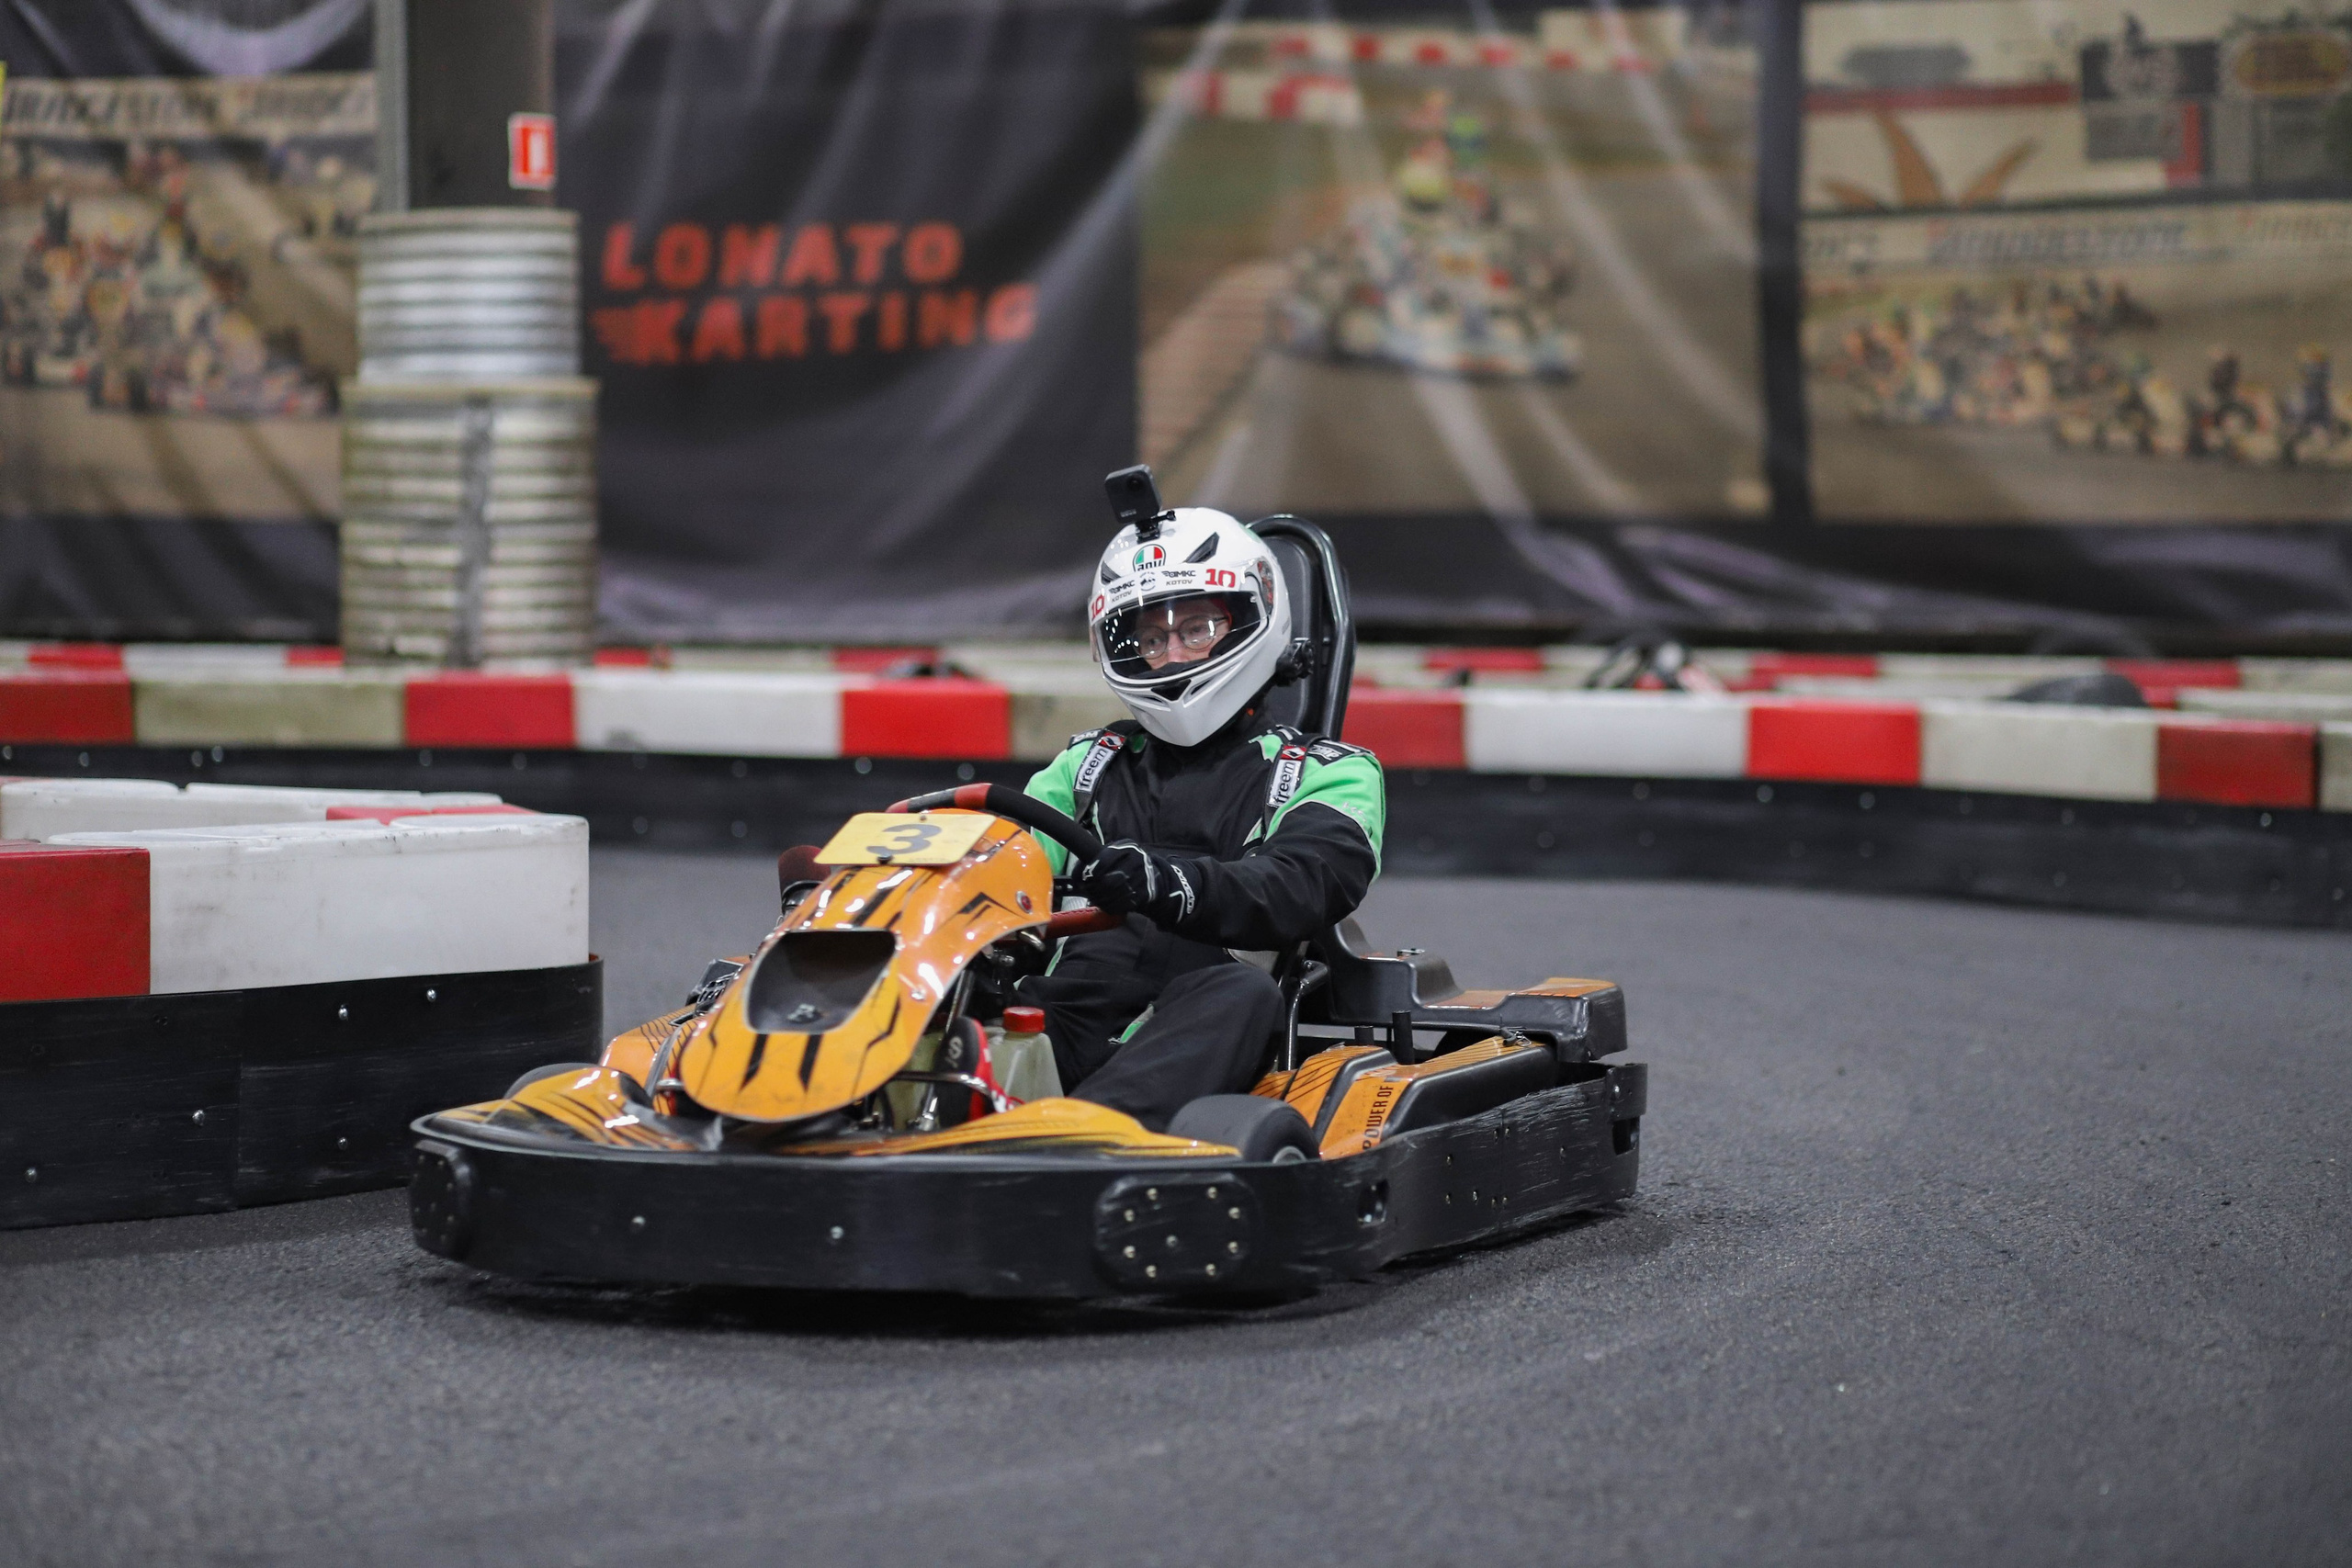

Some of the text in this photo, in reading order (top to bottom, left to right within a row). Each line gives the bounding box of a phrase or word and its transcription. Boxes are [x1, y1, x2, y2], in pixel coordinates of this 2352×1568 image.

[591, 282, 1041, 364] KARTING
[1205, 569, 1237, 588] 10
[1080, 748, 1108, 788] freem
[1274, 761, 1296, 805] freem
[865, 823, 943, 856] 3
[1362, 1085, 1395, 1150] POWER OF
